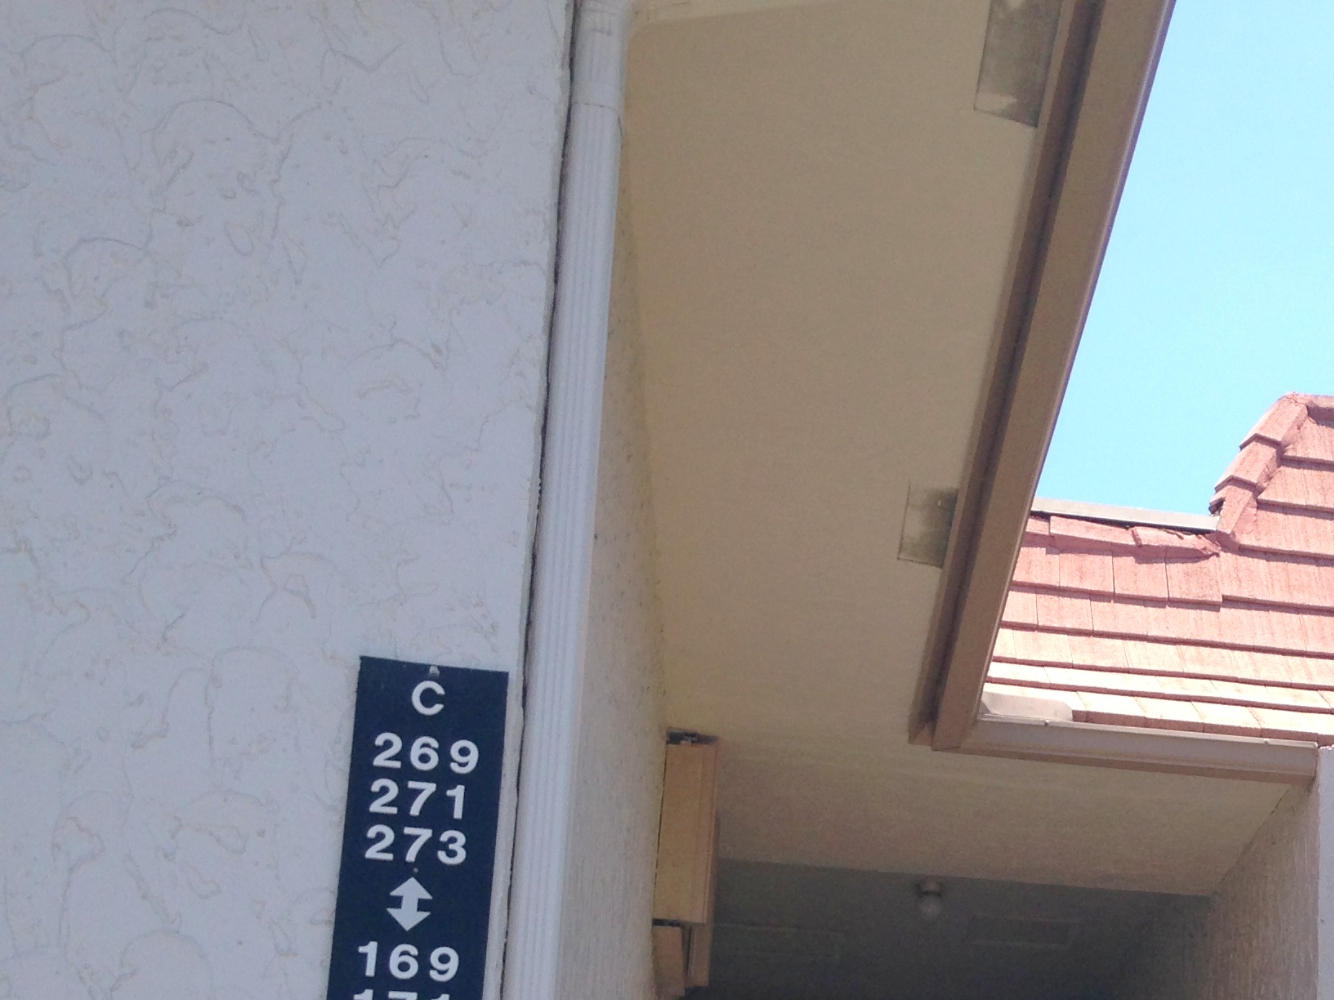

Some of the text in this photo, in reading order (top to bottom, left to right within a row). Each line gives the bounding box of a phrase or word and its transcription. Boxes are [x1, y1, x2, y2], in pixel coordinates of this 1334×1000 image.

[411, 680, 446, 716] C
[372, 732, 479, 774] 269
[369, 778, 465, 819] 271
[364, 824, 467, 865] 273
[358, 941, 459, 982] 169
